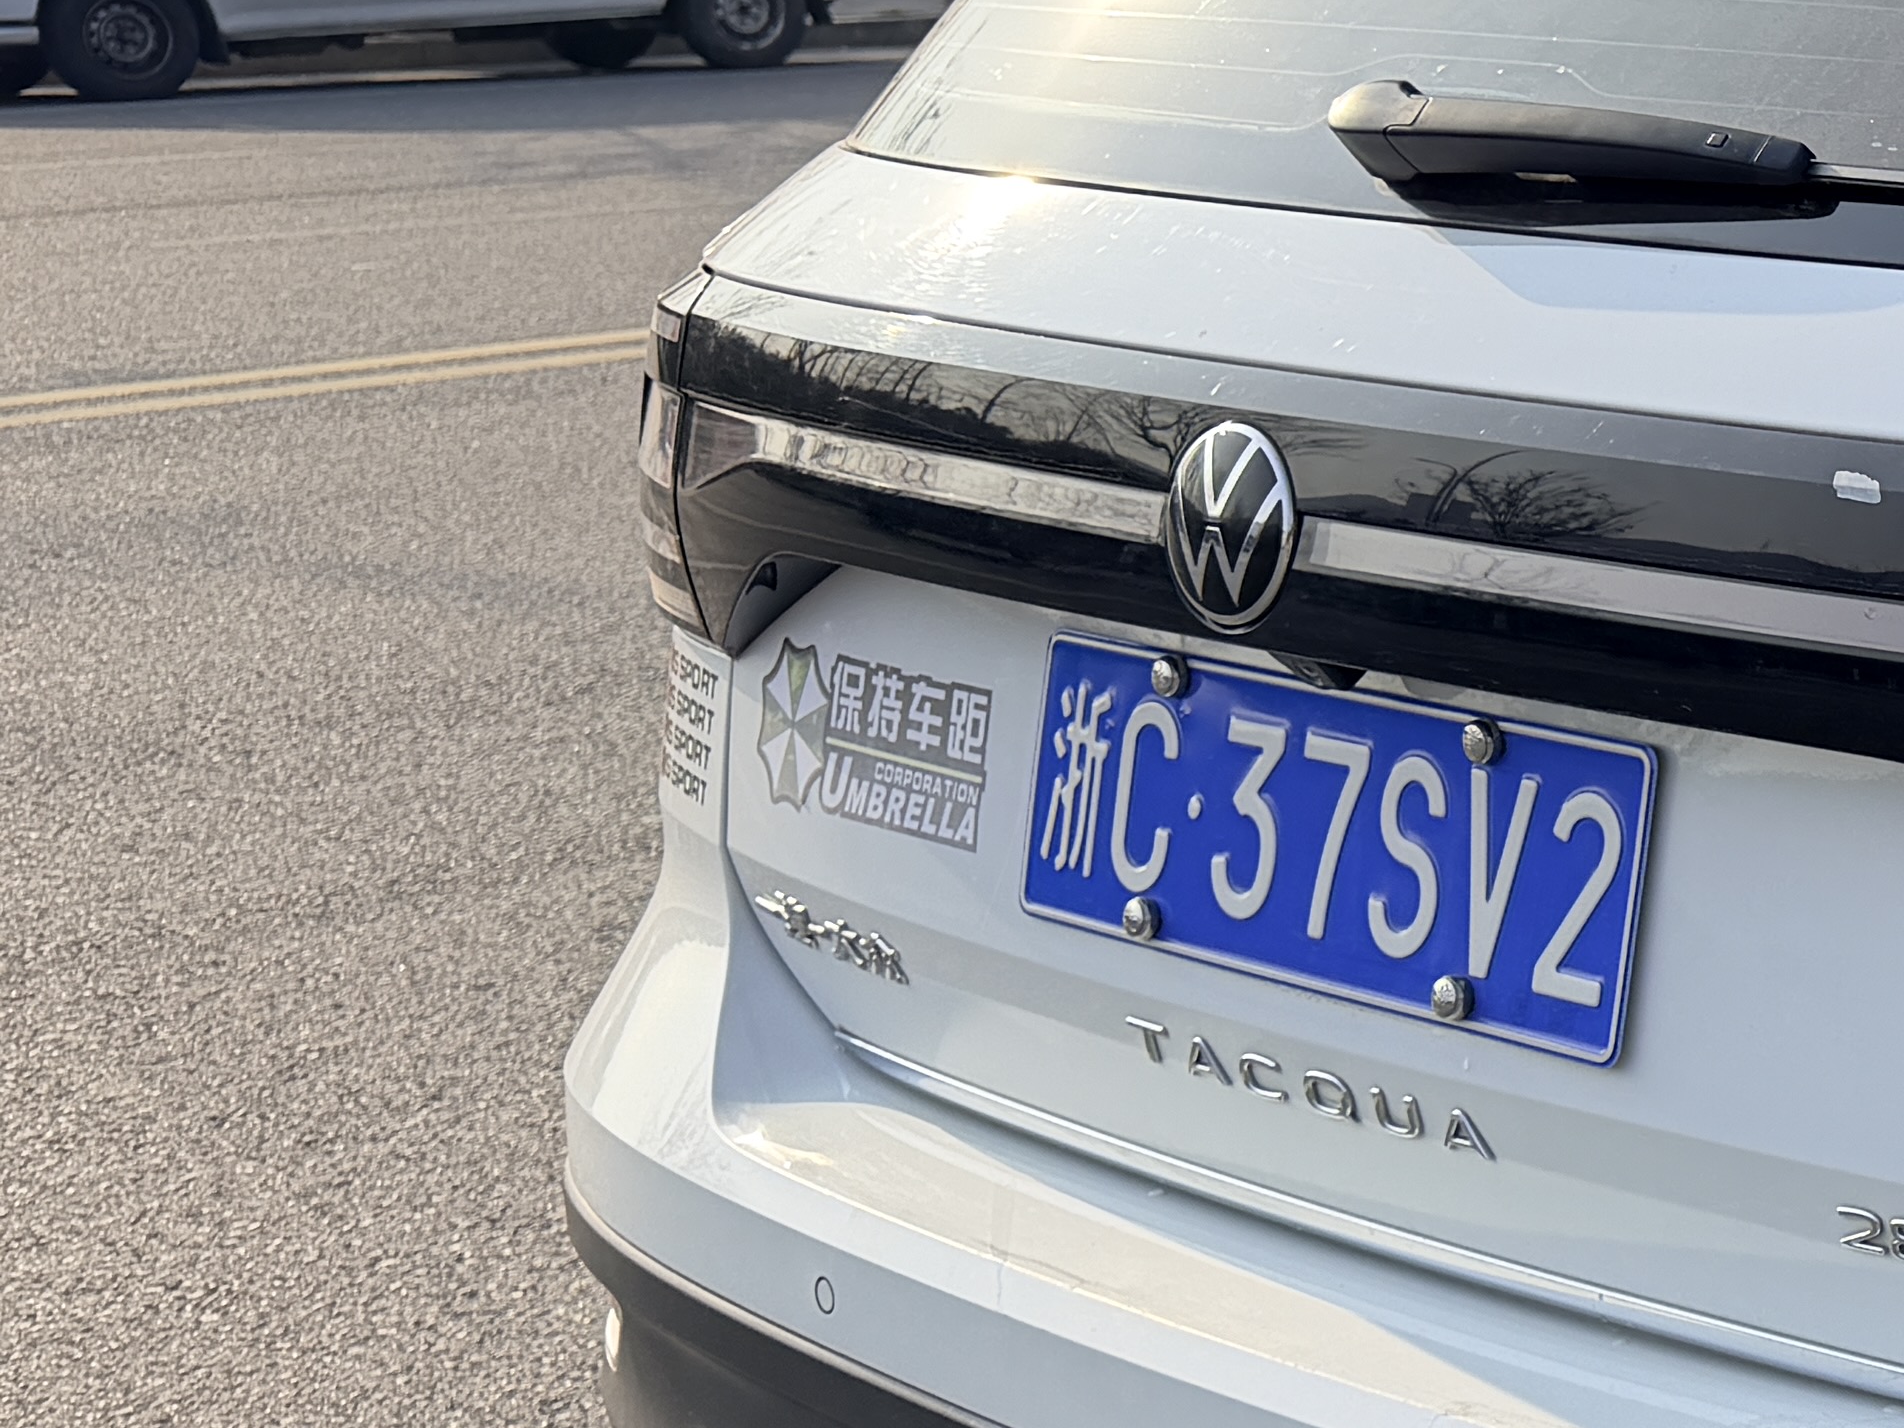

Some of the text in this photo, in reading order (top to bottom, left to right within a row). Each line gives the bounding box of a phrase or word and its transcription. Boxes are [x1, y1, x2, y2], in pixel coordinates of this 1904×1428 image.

[680, 655, 719, 700] SPORT
[676, 690, 715, 735] SPORT
[830, 660, 989, 764] 保持车距
[674, 725, 712, 770] SPORT
[671, 759, 708, 806] SPORT
[821, 751, 978, 845] UMBRELLA
[874, 761, 980, 806] CORPORATION
[1125, 1015, 1497, 1161] TACQUA
